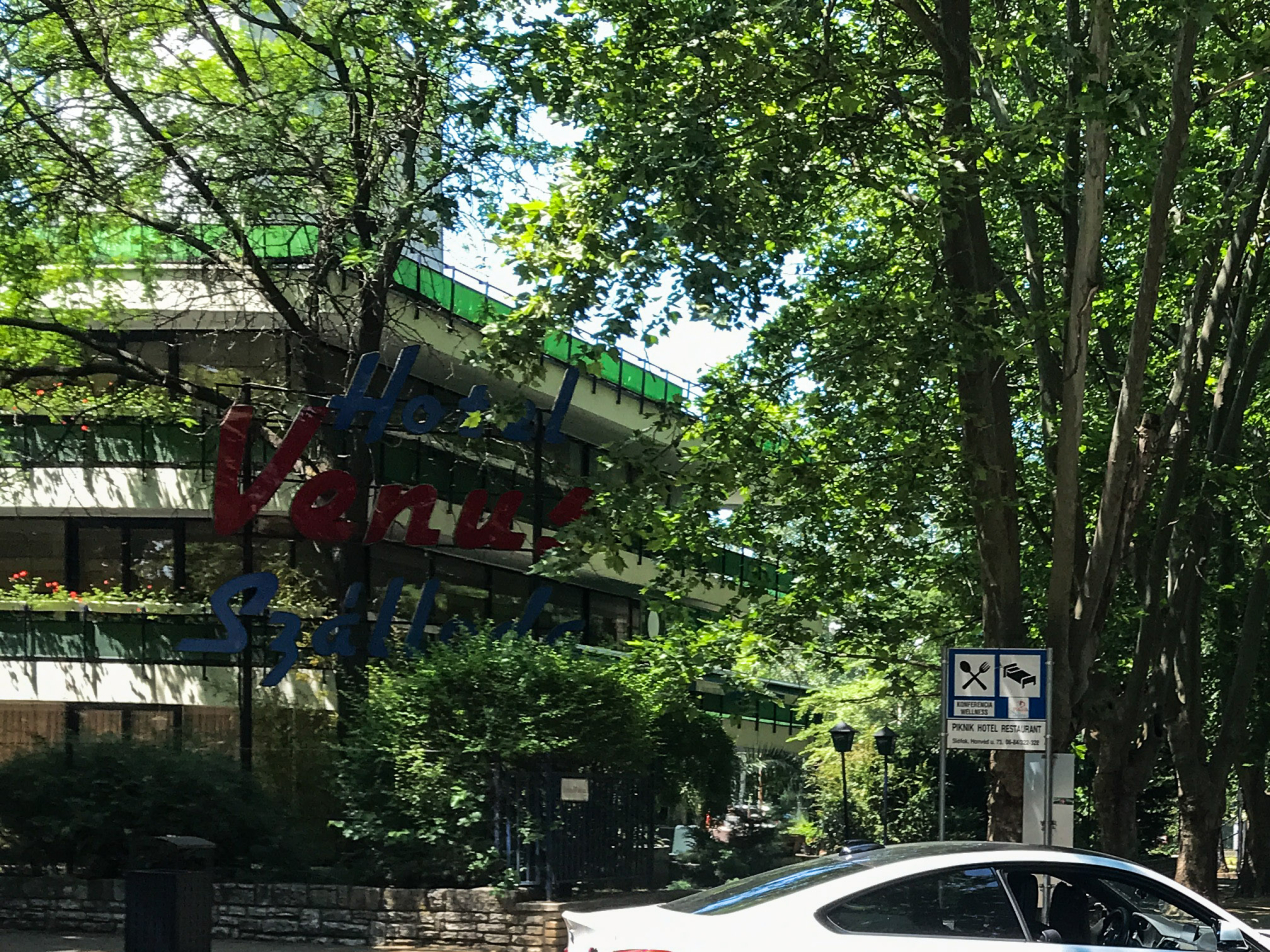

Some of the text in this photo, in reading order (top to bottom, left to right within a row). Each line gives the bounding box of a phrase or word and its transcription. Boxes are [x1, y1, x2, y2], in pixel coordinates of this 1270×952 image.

[329, 345, 579, 444] Hotel
[960, 708, 988, 716] WELLNESS
[952, 723, 1042, 734] PIKNIK HOTEL RESTAURANT
